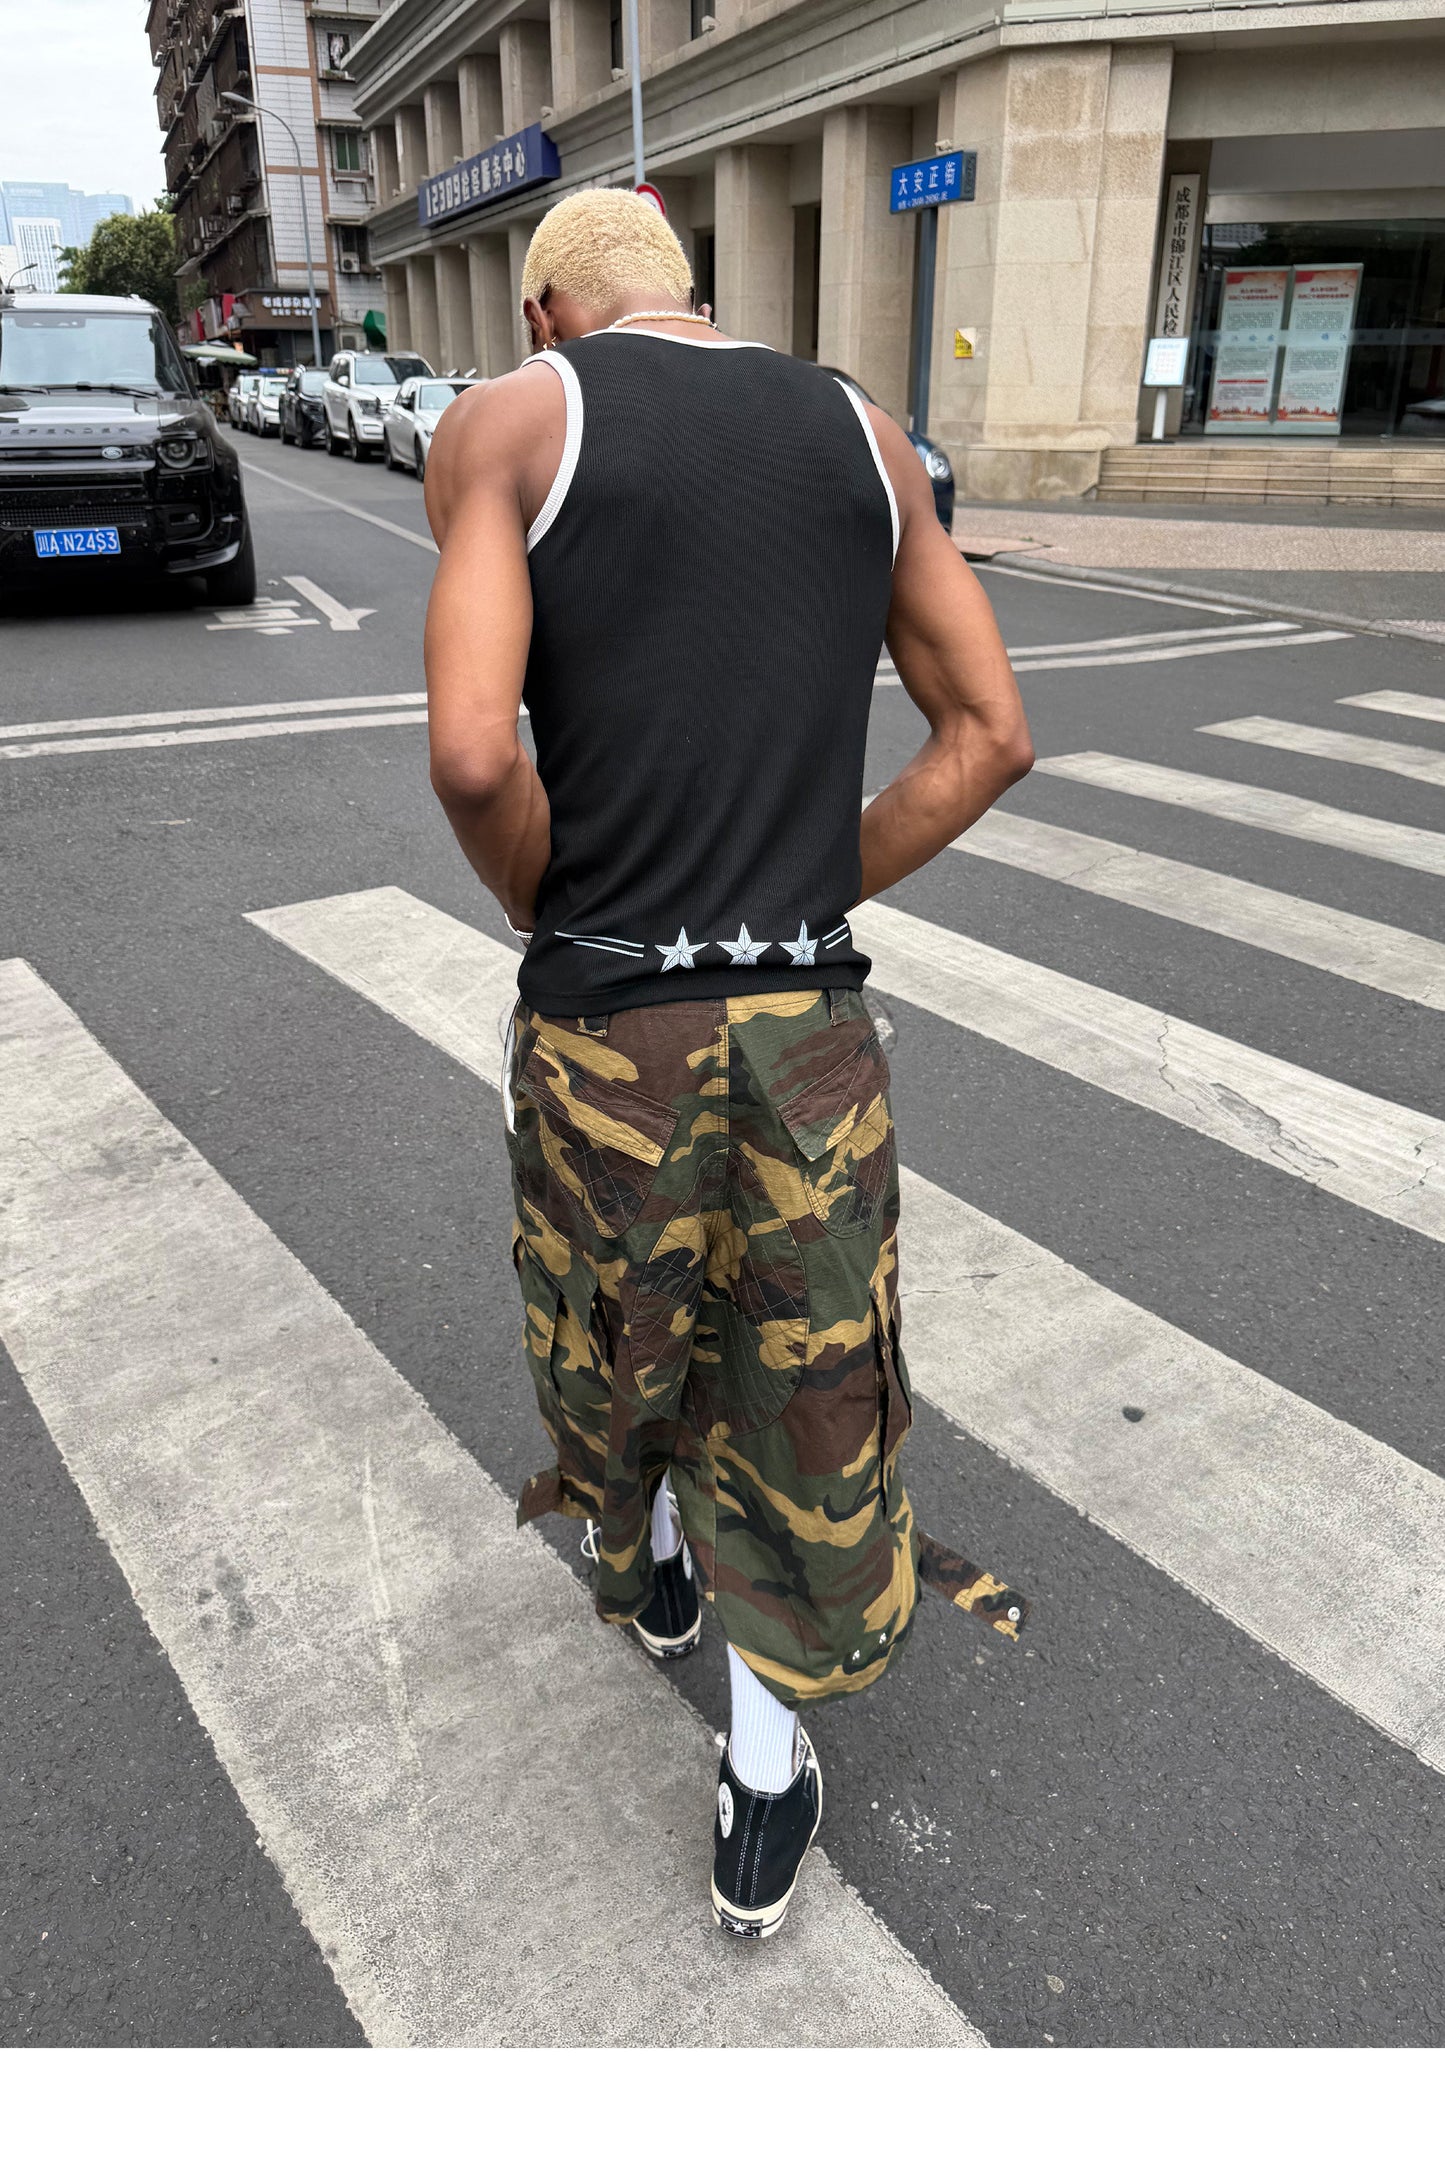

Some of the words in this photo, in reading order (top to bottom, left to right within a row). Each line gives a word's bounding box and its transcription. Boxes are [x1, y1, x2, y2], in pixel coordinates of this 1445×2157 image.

[426, 142, 525, 218] 12309检察服务中心
[898, 160, 956, 196] 大安正街
[0, 427, 129, 435] EFENDER
